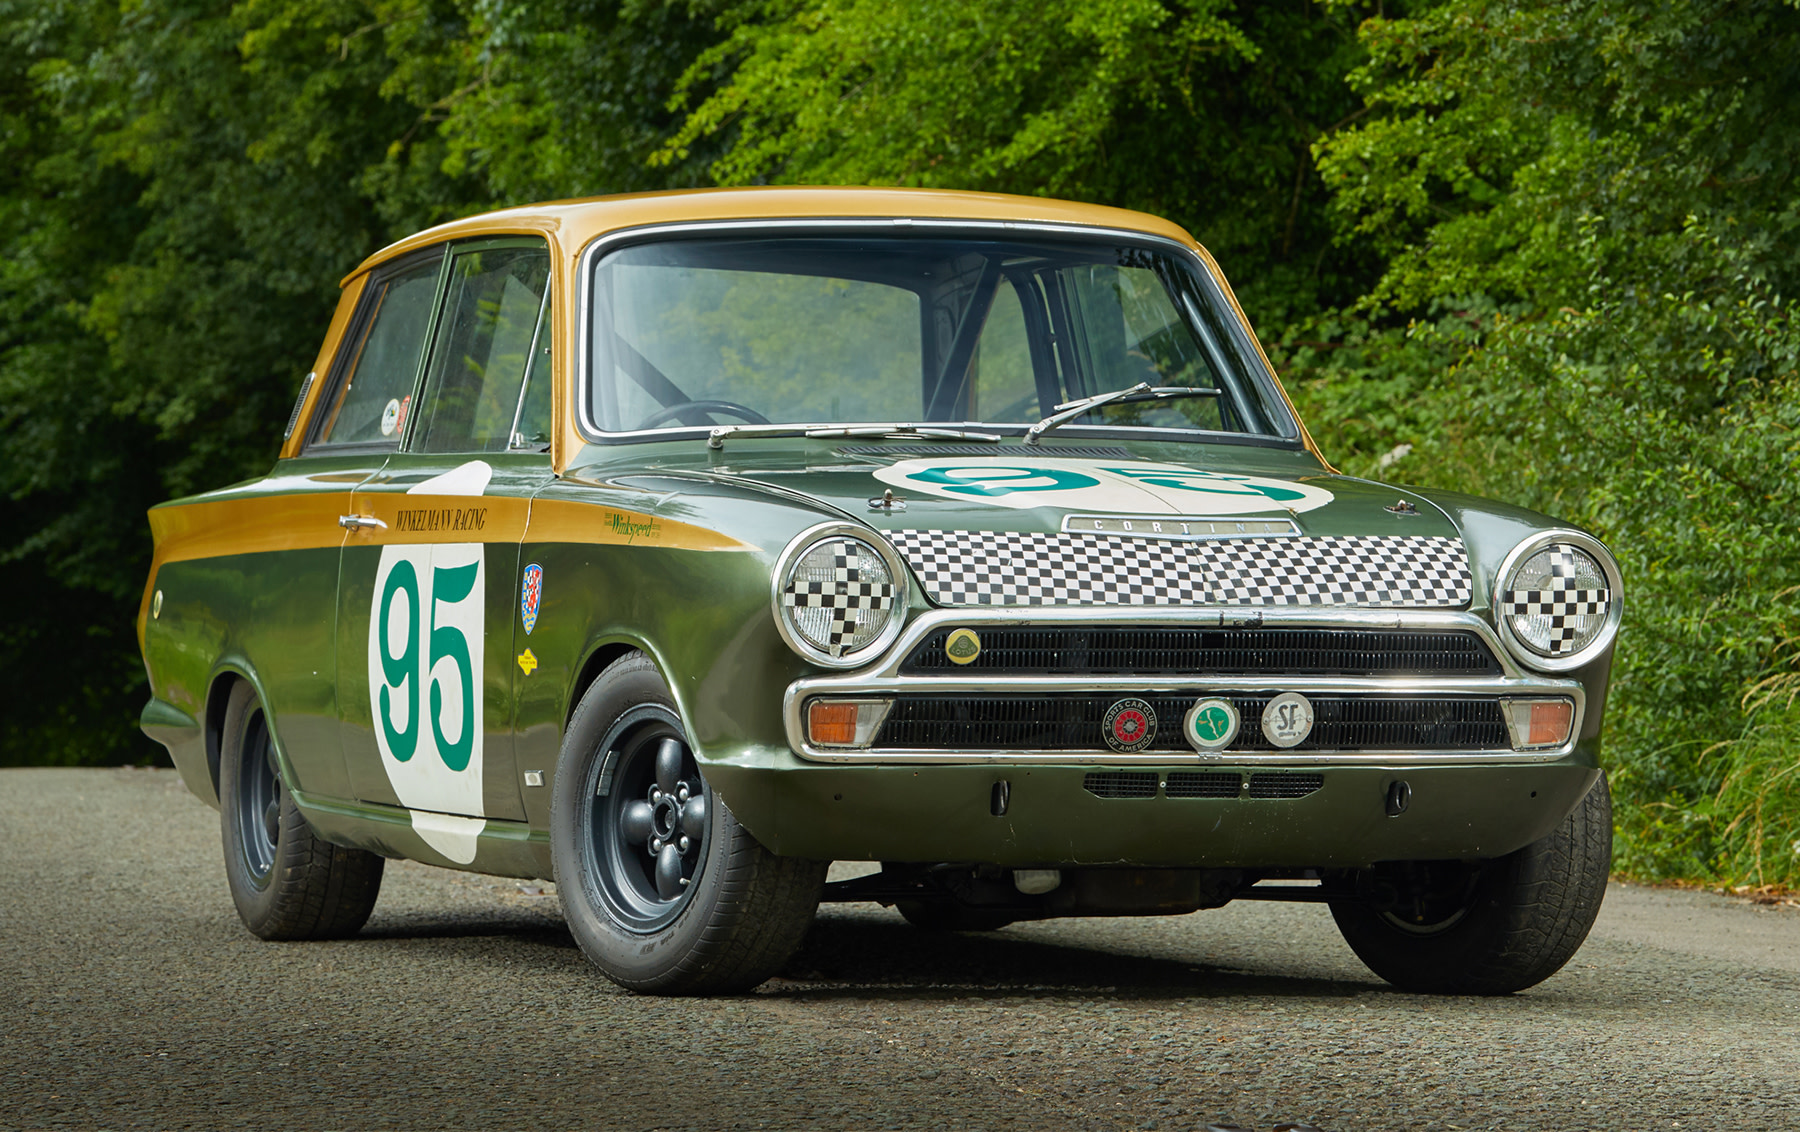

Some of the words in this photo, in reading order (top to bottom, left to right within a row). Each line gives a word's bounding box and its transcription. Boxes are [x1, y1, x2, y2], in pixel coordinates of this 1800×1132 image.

[905, 466, 1307, 502] 95
[395, 509, 454, 532] WINKELMANN
[452, 508, 488, 531] RACING
[612, 513, 654, 544] Winkspeed
[1094, 520, 1272, 534] CORTINA
[951, 646, 977, 655] LOTUS
[379, 559, 480, 772] 95
[1105, 703, 1124, 730] SPORTS
[1124, 700, 1144, 710] CAR
[1143, 706, 1155, 727] CLUB
[1277, 704, 1299, 730] SF
[1108, 736, 1119, 746] OF
[1118, 734, 1153, 752] AMERICA
